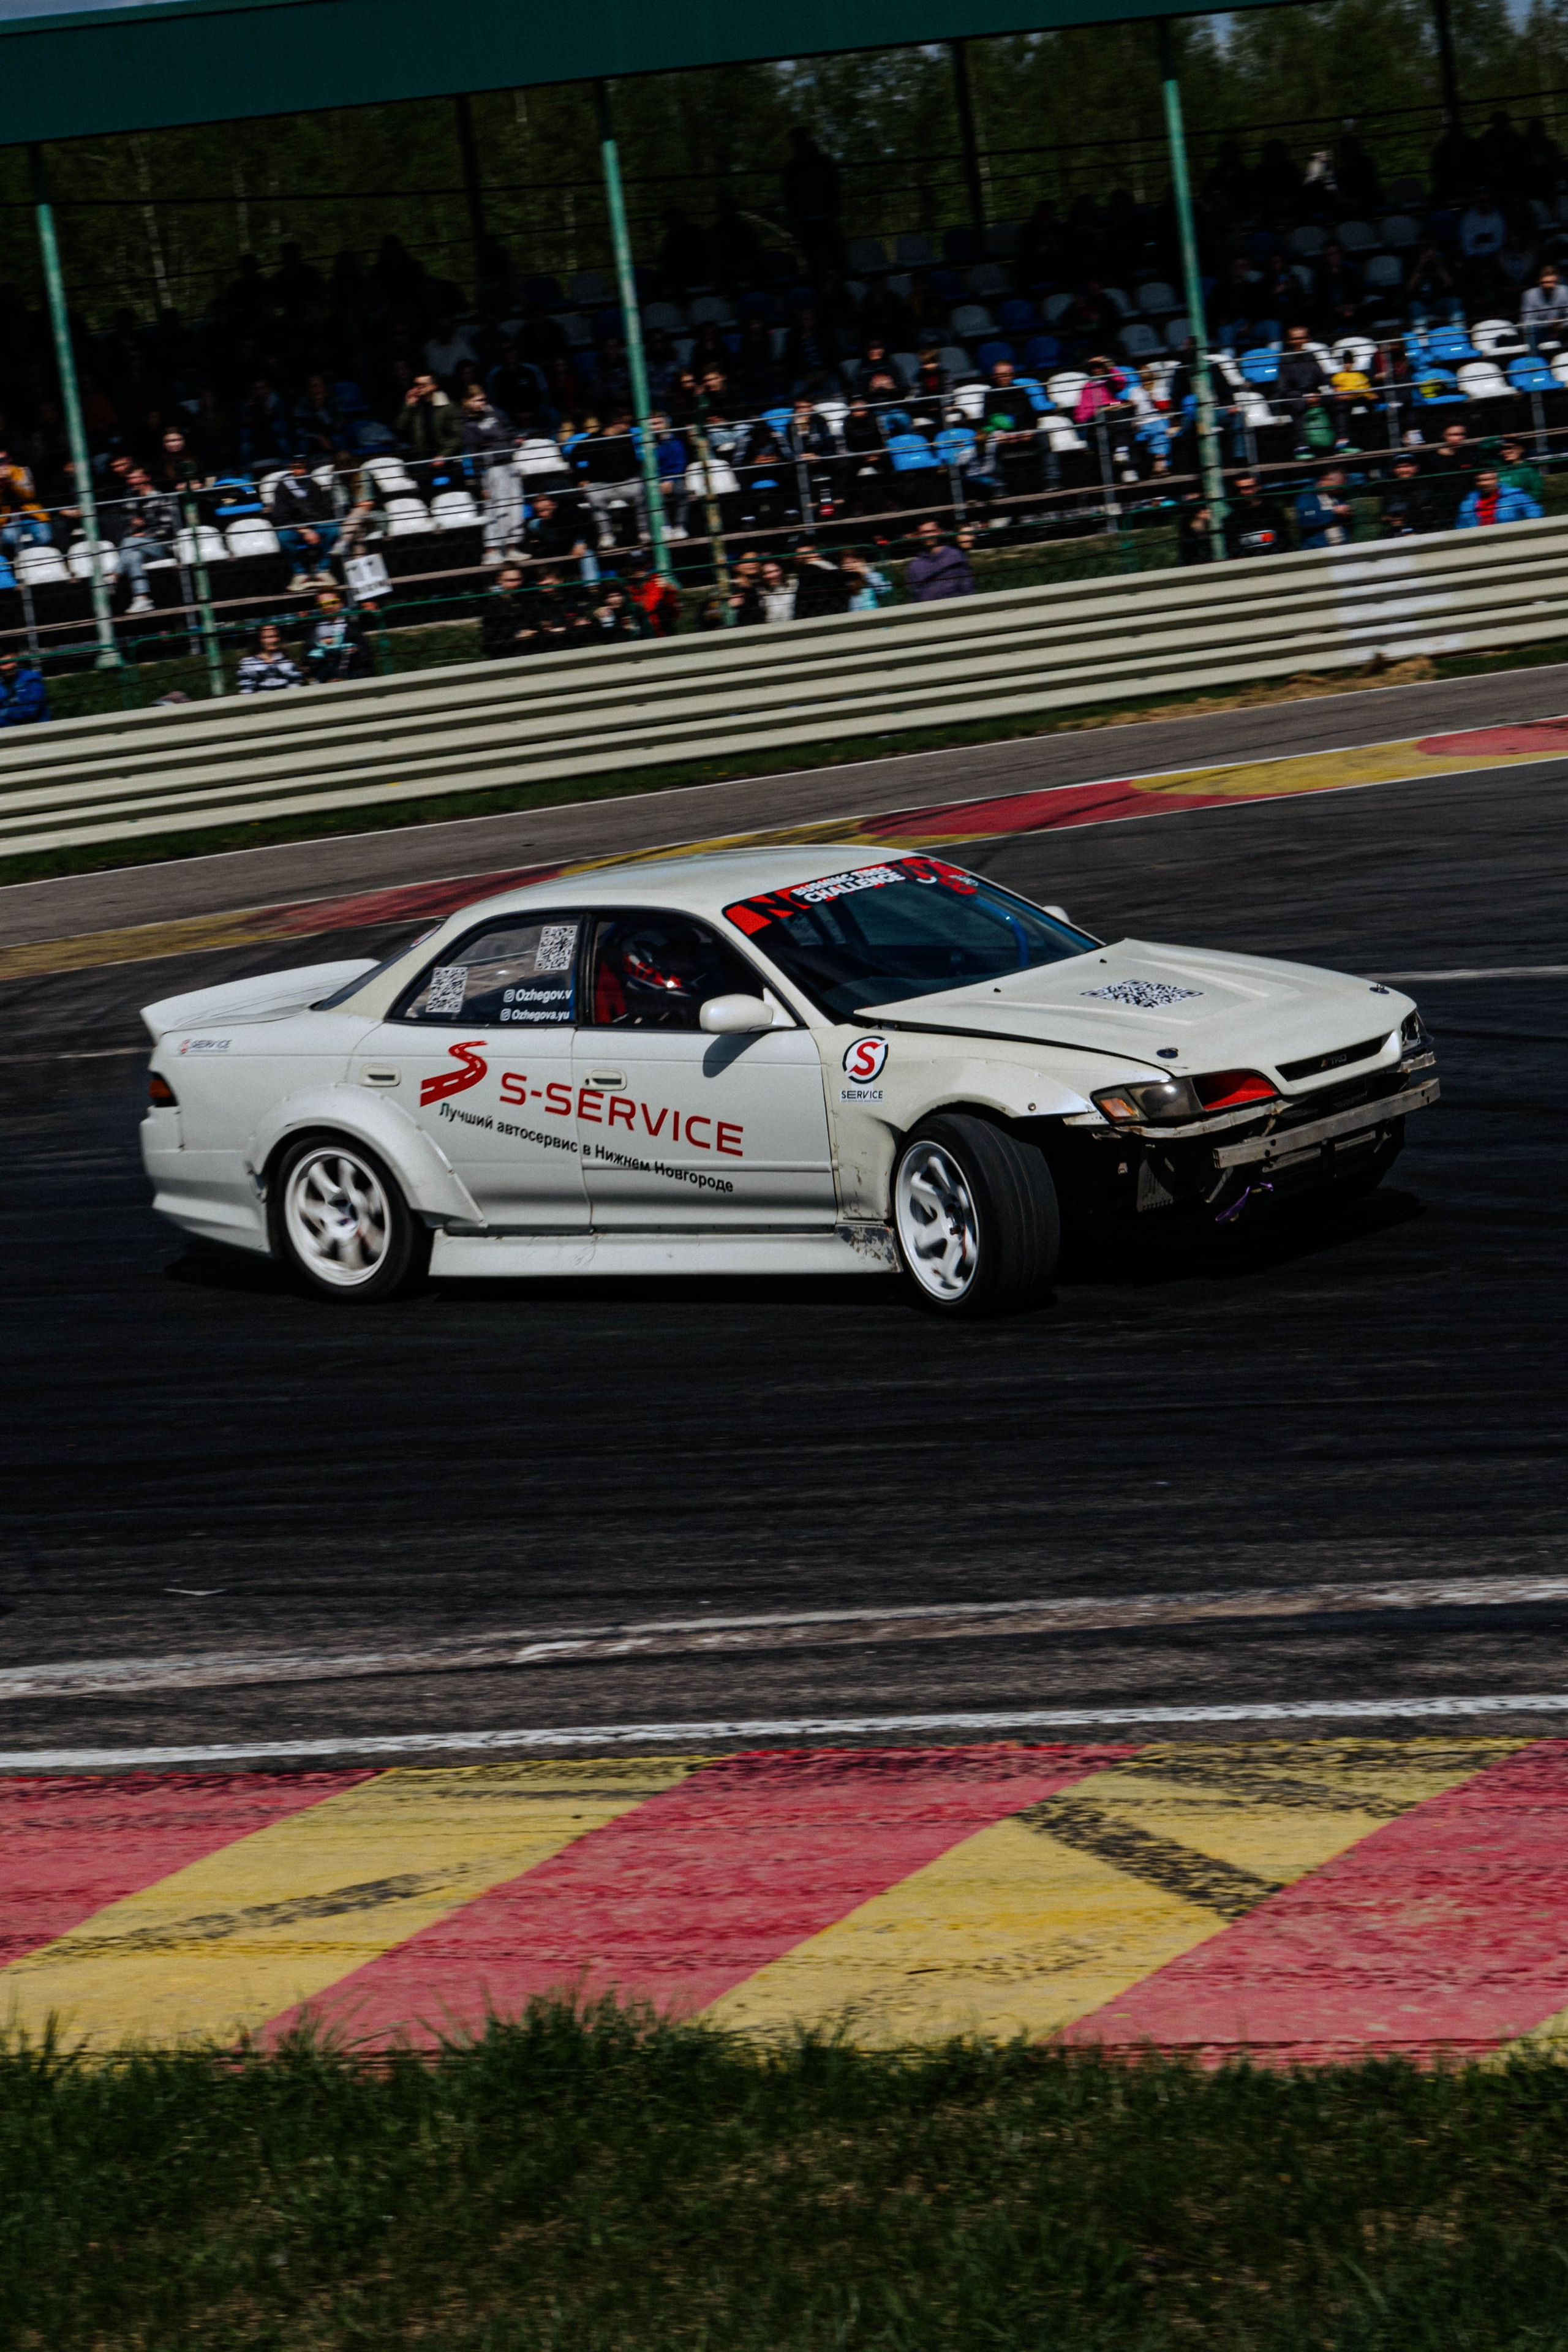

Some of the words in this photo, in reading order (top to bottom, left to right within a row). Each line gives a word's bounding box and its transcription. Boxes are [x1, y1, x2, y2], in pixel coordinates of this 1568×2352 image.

[804, 871, 906, 903] CHALLENGE
[500, 1072, 742, 1156] S-SERVICE
[841, 1090, 884, 1099] SERVICE
[439, 1102, 493, 1129] Лучший
[497, 1121, 578, 1153] автосервис
[582, 1144, 591, 1156] в
[595, 1144, 650, 1172] Нижнем
[654, 1161, 734, 1194] Новгороде
